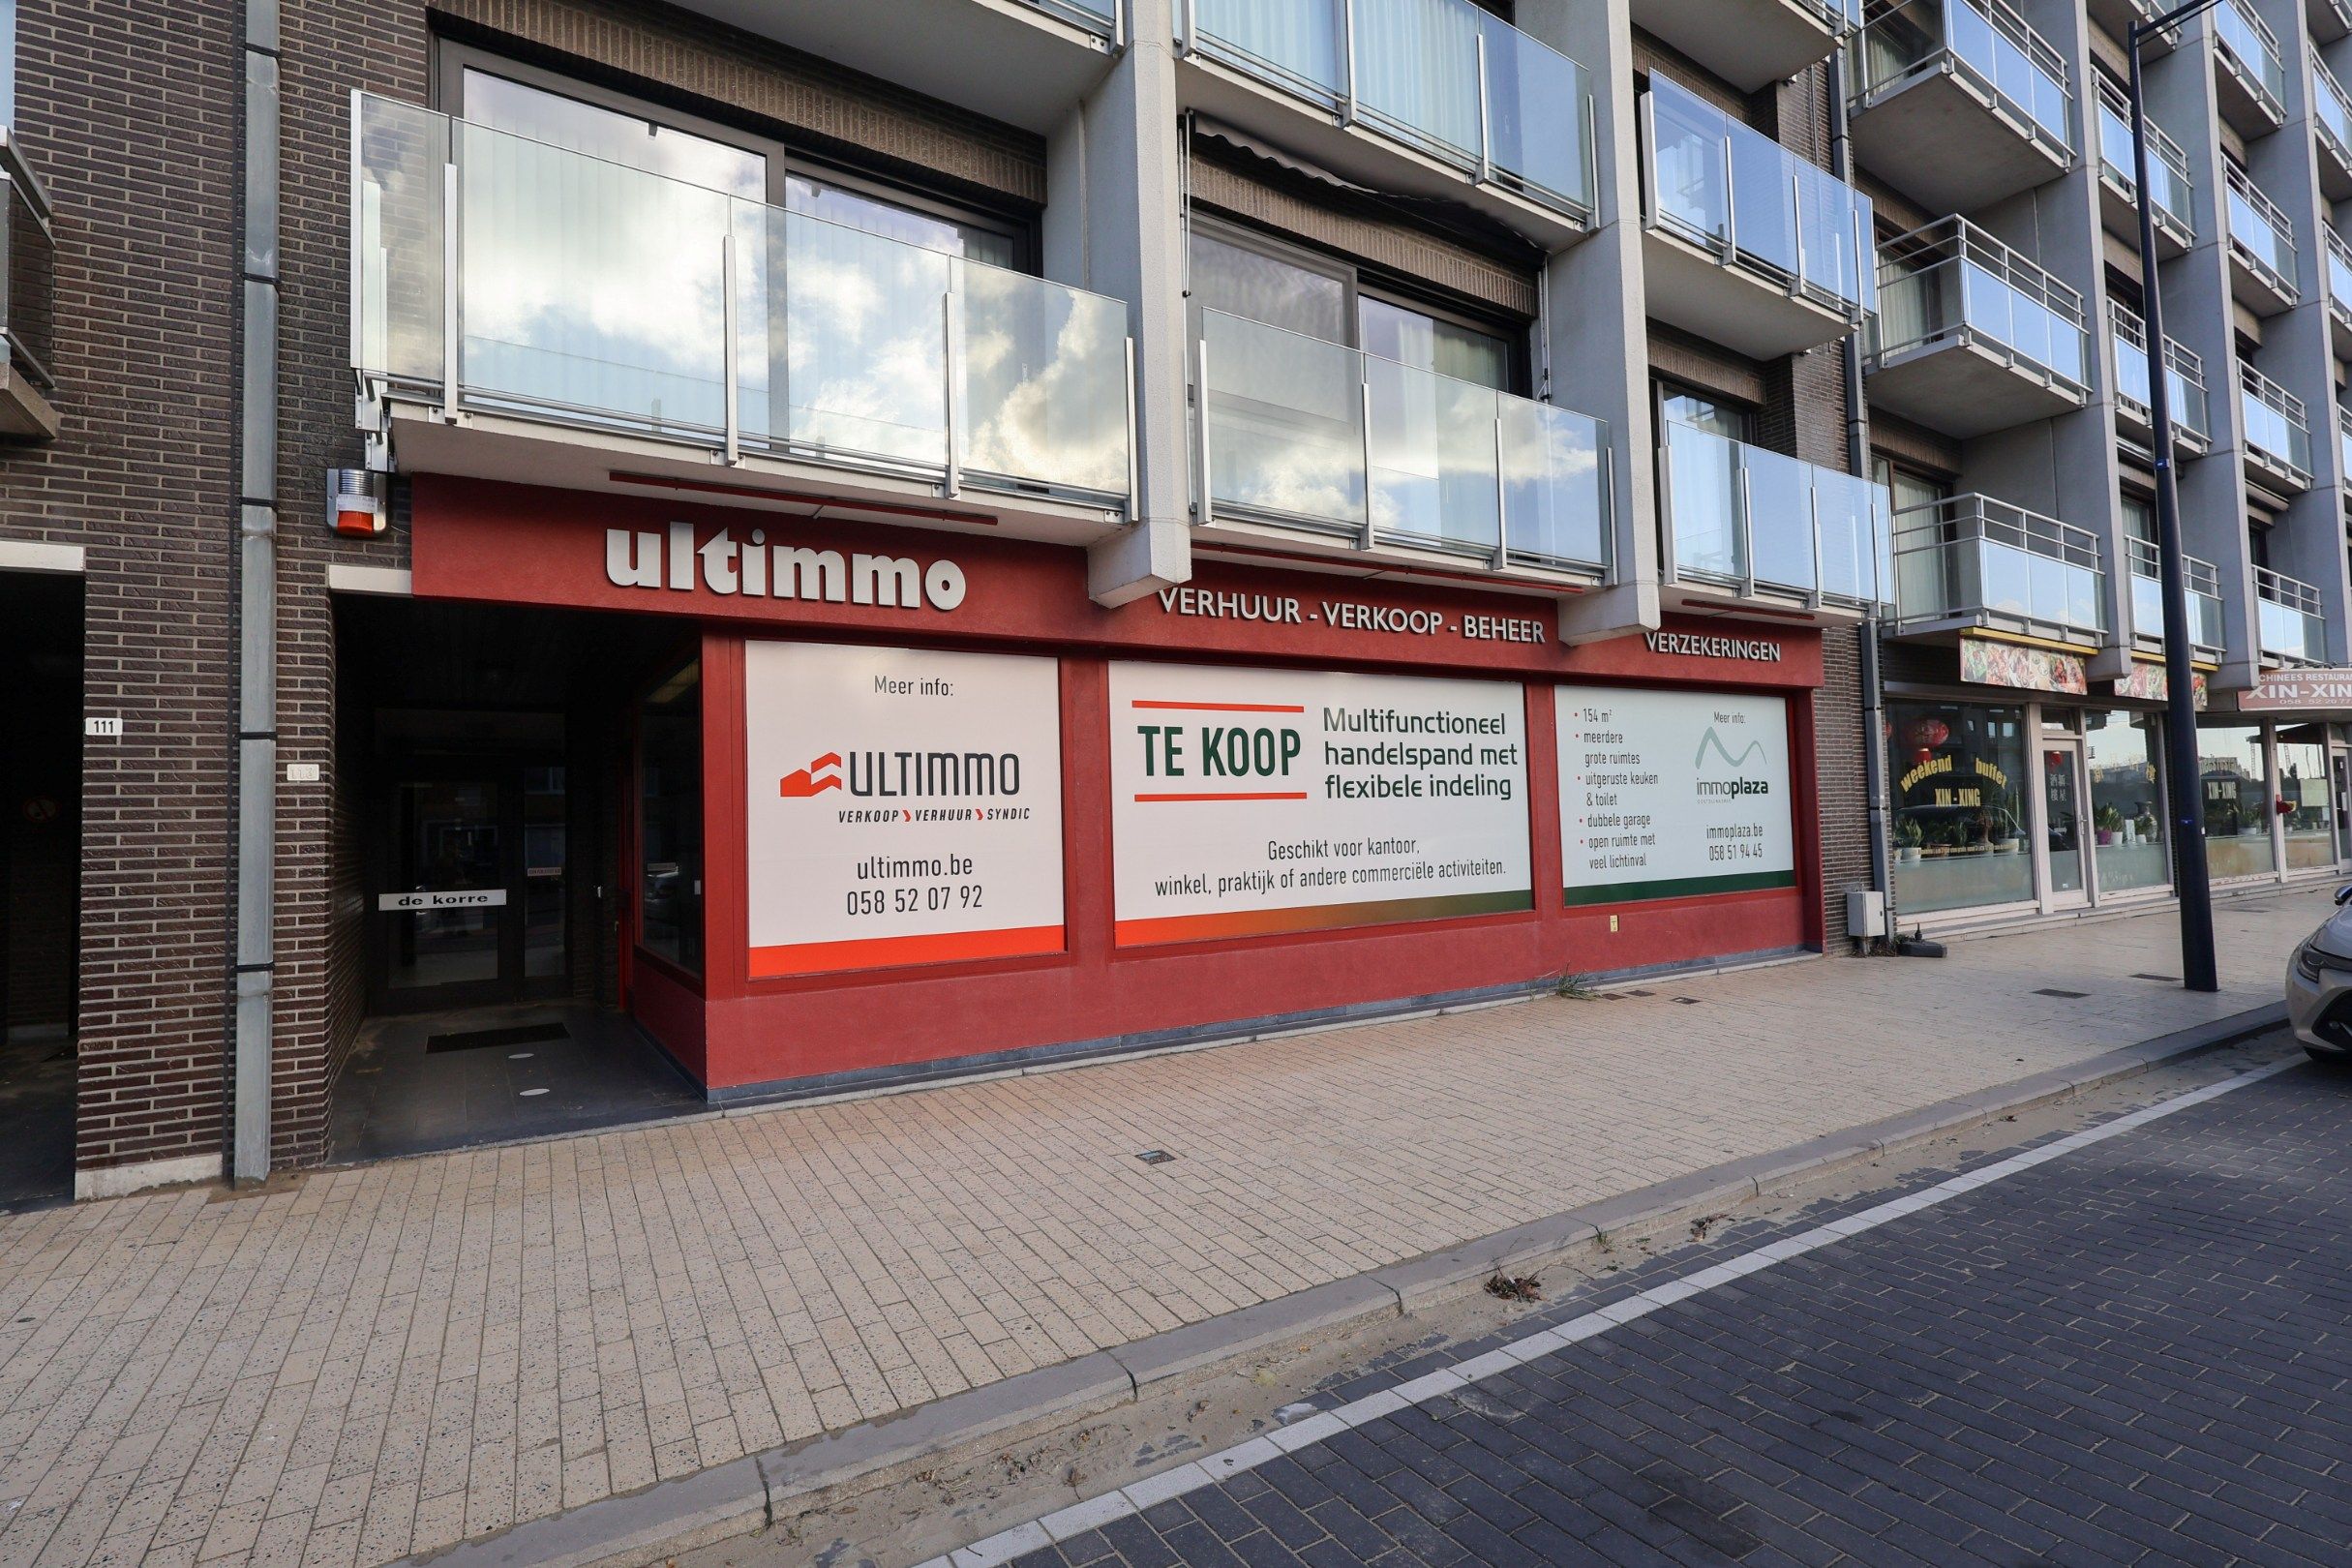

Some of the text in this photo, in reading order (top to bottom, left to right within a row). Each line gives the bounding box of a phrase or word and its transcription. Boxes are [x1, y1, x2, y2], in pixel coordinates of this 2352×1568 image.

[606, 522, 966, 611] ultimmo
[1160, 588, 1301, 623] VERHUUR
[1322, 602, 1442, 635] VERKOOP
[1463, 615, 1546, 643] BEHEER
[1645, 632, 1781, 661] VERZEKERINGEN
[874, 675, 953, 696] Meer info:
[1324, 708, 1505, 735] Multifunctioneel
[1583, 709, 1599, 722] 154
[1713, 712, 1745, 724] Meer info:
[94, 720, 113, 733] 111
[1583, 732, 1622, 743] meerdere
[1138, 725, 1301, 777] TE KOOP
[1324, 741, 1518, 770] handelspand met
[1585, 751, 1640, 767] grote ruimtes
[850, 752, 1020, 797] ULTIMMO
[1585, 772, 1658, 788] uitgeruste keuken
[1901, 755, 2007, 792] weekend buffet
[1325, 774, 1512, 800] flexibele indeling
[1697, 777, 1768, 799] immoplaza
[1586, 794, 1617, 805] & toilet
[838, 807, 1030, 823] VERKOOP VERHUUR SYNDIC
[1587, 813, 1650, 829] dubbele garage
[1588, 833, 1655, 850] open ruimte met
[1706, 823, 1764, 840] immoplaza.be
[1268, 839, 1329, 860] Geschikt
[1334, 841, 1362, 858] voor
[1709, 844, 1763, 861] 058 51 94 45
[858, 855, 973, 880] ultimmo.be
[1589, 854, 1646, 869] veel lichtinval
[1155, 860, 1506, 897] winkel, praktijk of andere commerciële activiteiten.
[399, 894, 488, 906] de korre
[847, 886, 982, 915] 058 52 07 92
